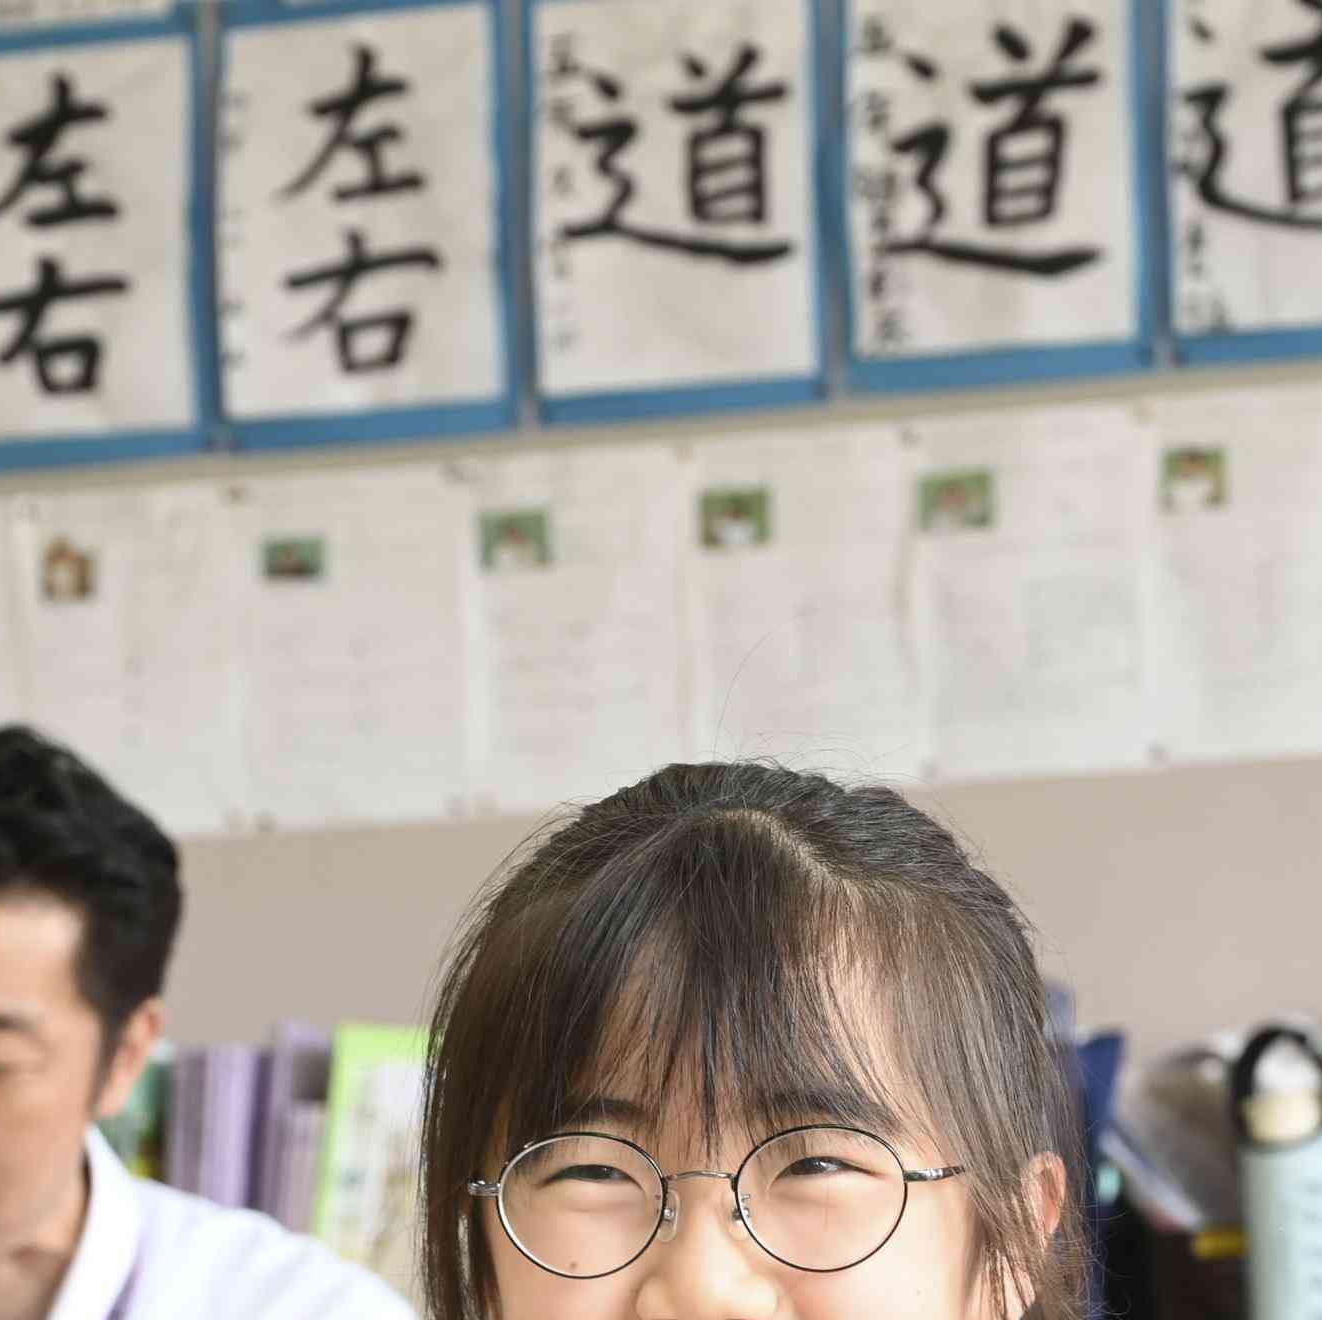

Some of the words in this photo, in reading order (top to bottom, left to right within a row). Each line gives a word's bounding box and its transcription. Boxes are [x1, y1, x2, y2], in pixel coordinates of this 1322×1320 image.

[277, 43, 444, 374] 左右
[561, 43, 792, 271] 道
[880, 16, 1102, 278] 道
